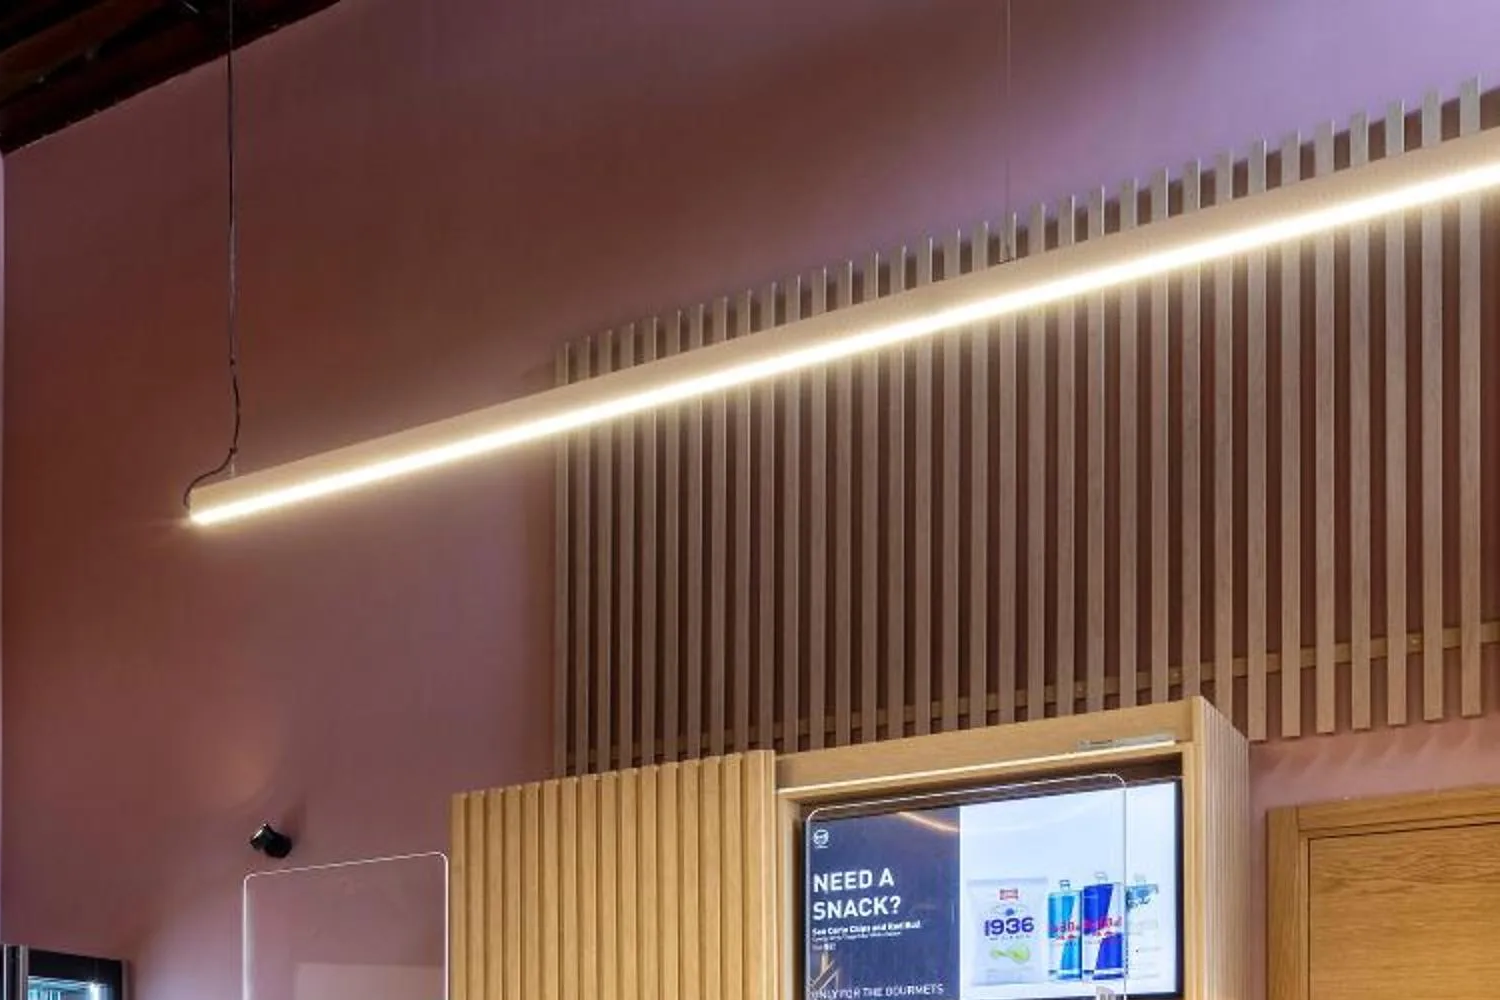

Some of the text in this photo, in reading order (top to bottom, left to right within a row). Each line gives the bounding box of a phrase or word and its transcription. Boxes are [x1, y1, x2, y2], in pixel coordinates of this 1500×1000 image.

[813, 867, 894, 893] NEED A
[813, 895, 901, 920] SNACK?
[984, 917, 1035, 937] 1936
